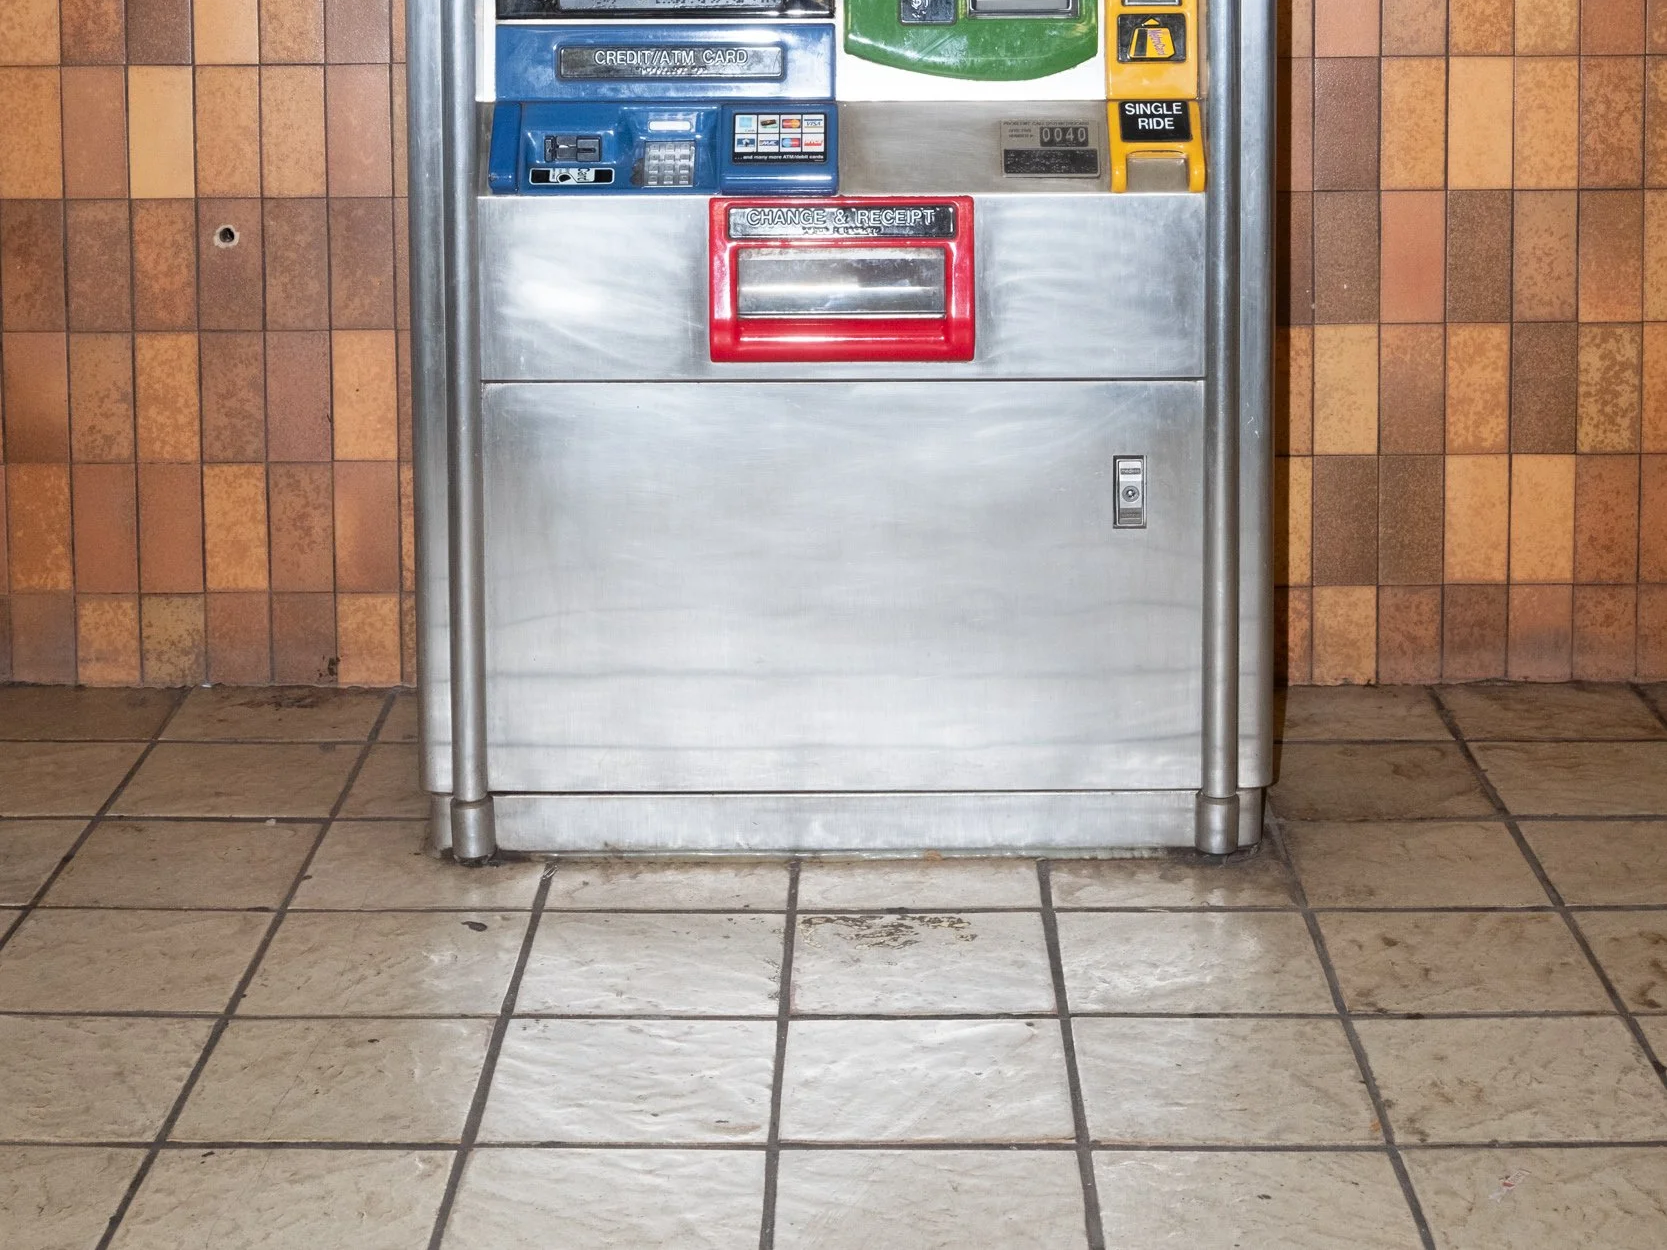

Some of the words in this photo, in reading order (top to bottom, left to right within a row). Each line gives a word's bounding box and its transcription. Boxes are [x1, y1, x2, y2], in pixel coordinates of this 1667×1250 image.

[702, 50, 748, 65] CARD
[1125, 103, 1183, 116] SINGLE
[1138, 117, 1175, 130] RIDE
[1042, 127, 1086, 142] 0040
[747, 209, 826, 226] CHANGE
[834, 209, 848, 225] &
[857, 209, 936, 226] RECEIPT
